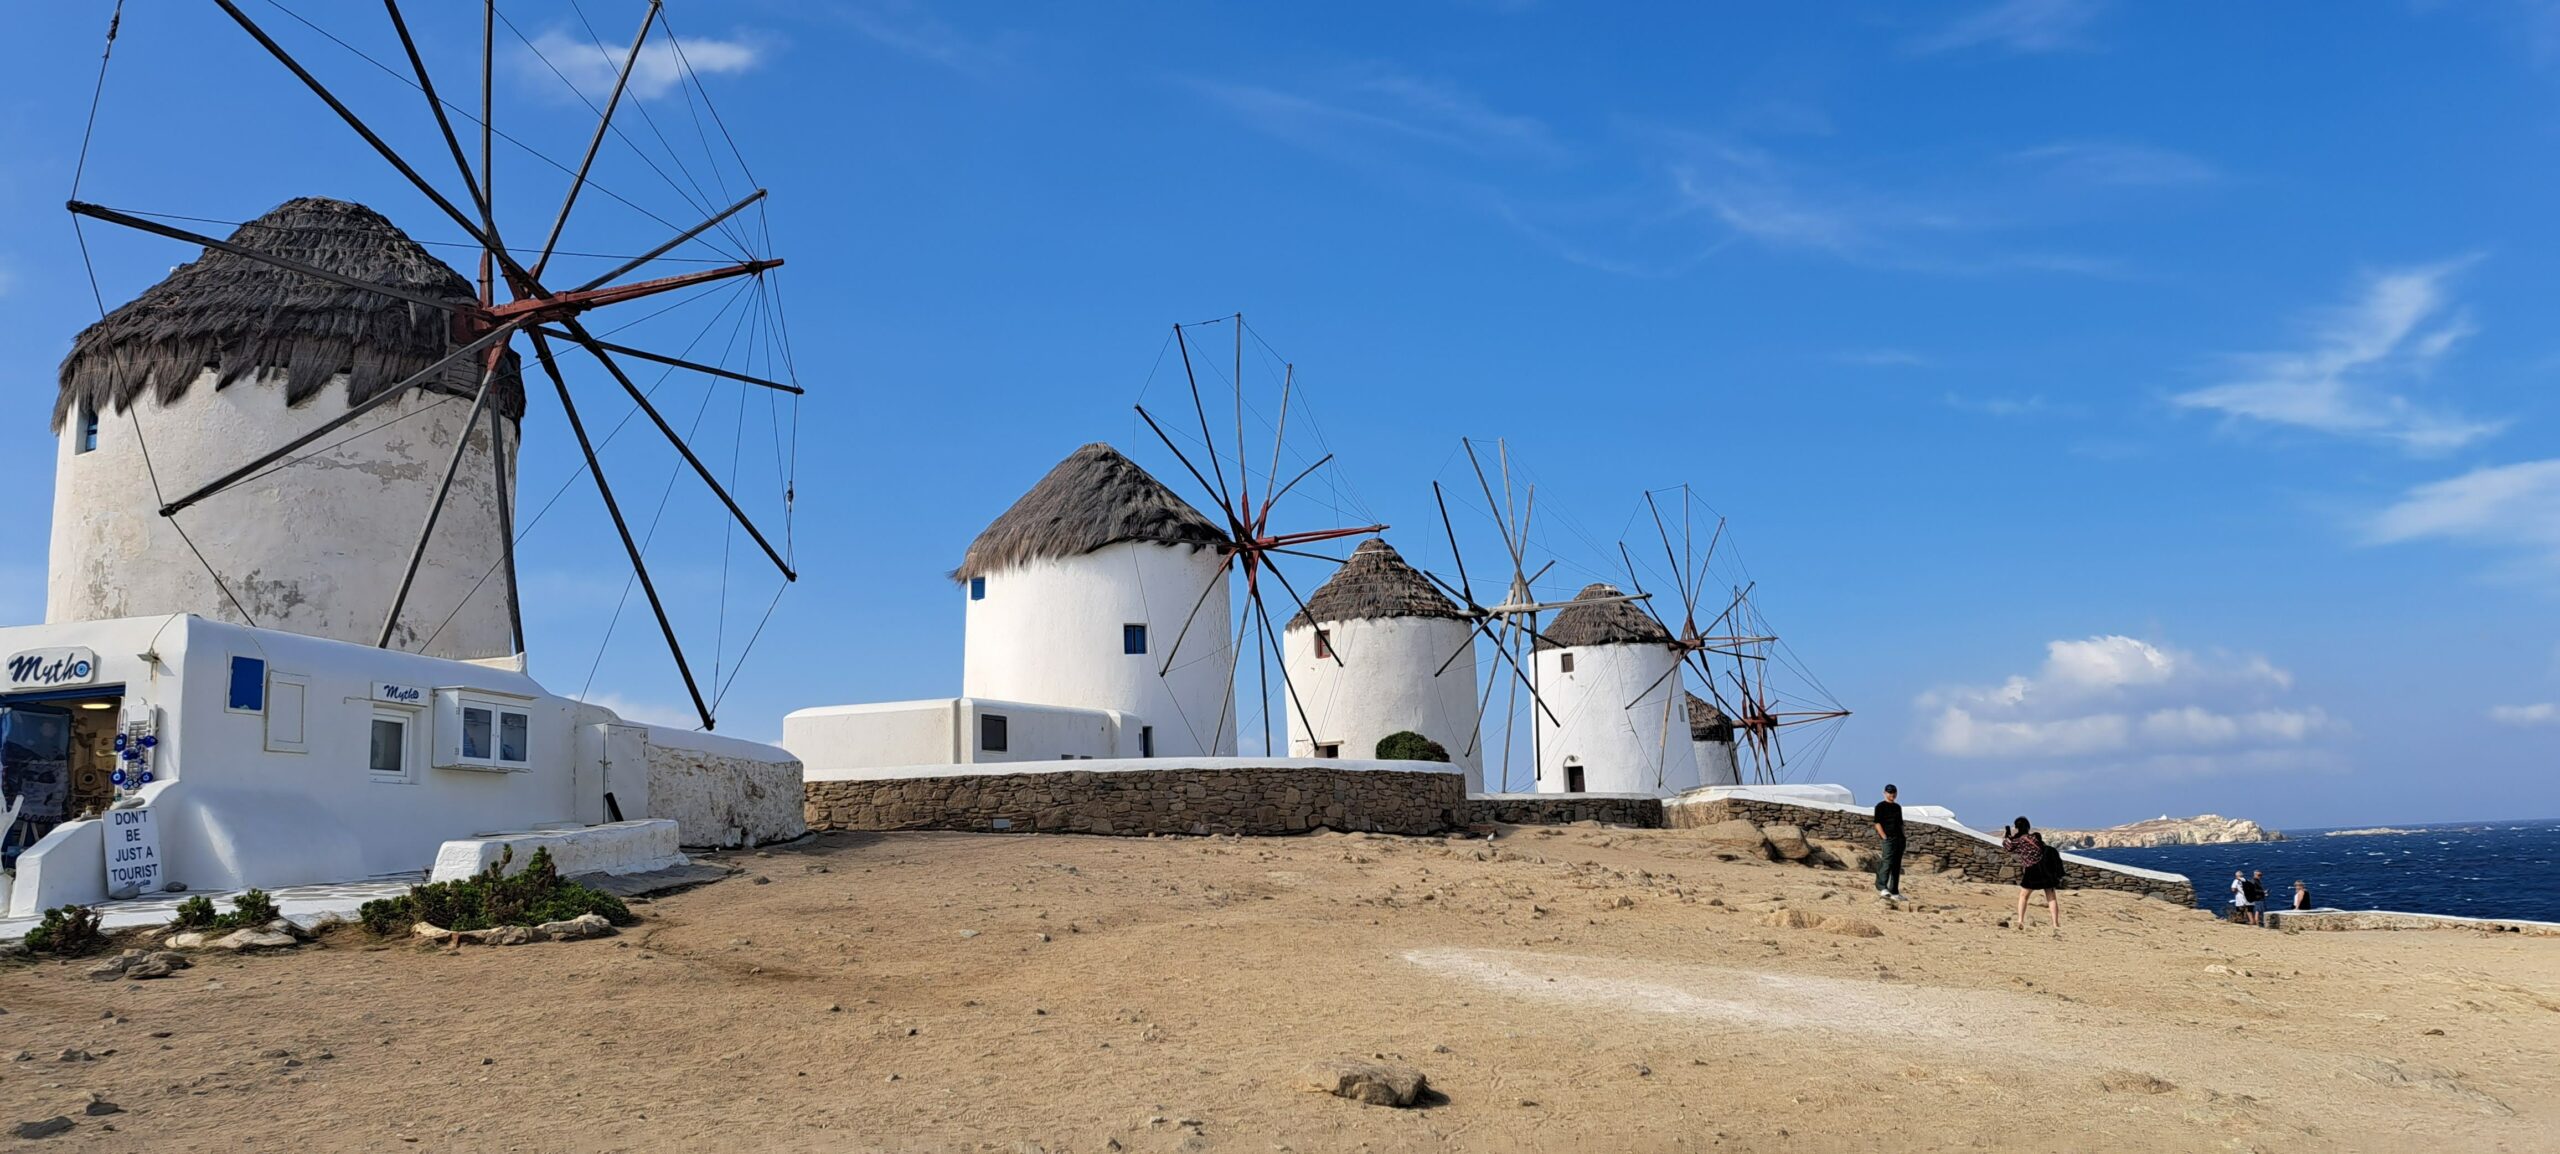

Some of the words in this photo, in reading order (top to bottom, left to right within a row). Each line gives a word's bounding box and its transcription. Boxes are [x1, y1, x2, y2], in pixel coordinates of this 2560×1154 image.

[115, 810, 148, 826] DON'T
[126, 828, 141, 842] BE
[115, 846, 143, 862] JUST
[146, 845, 154, 859] A
[111, 863, 158, 882] TOURIST
